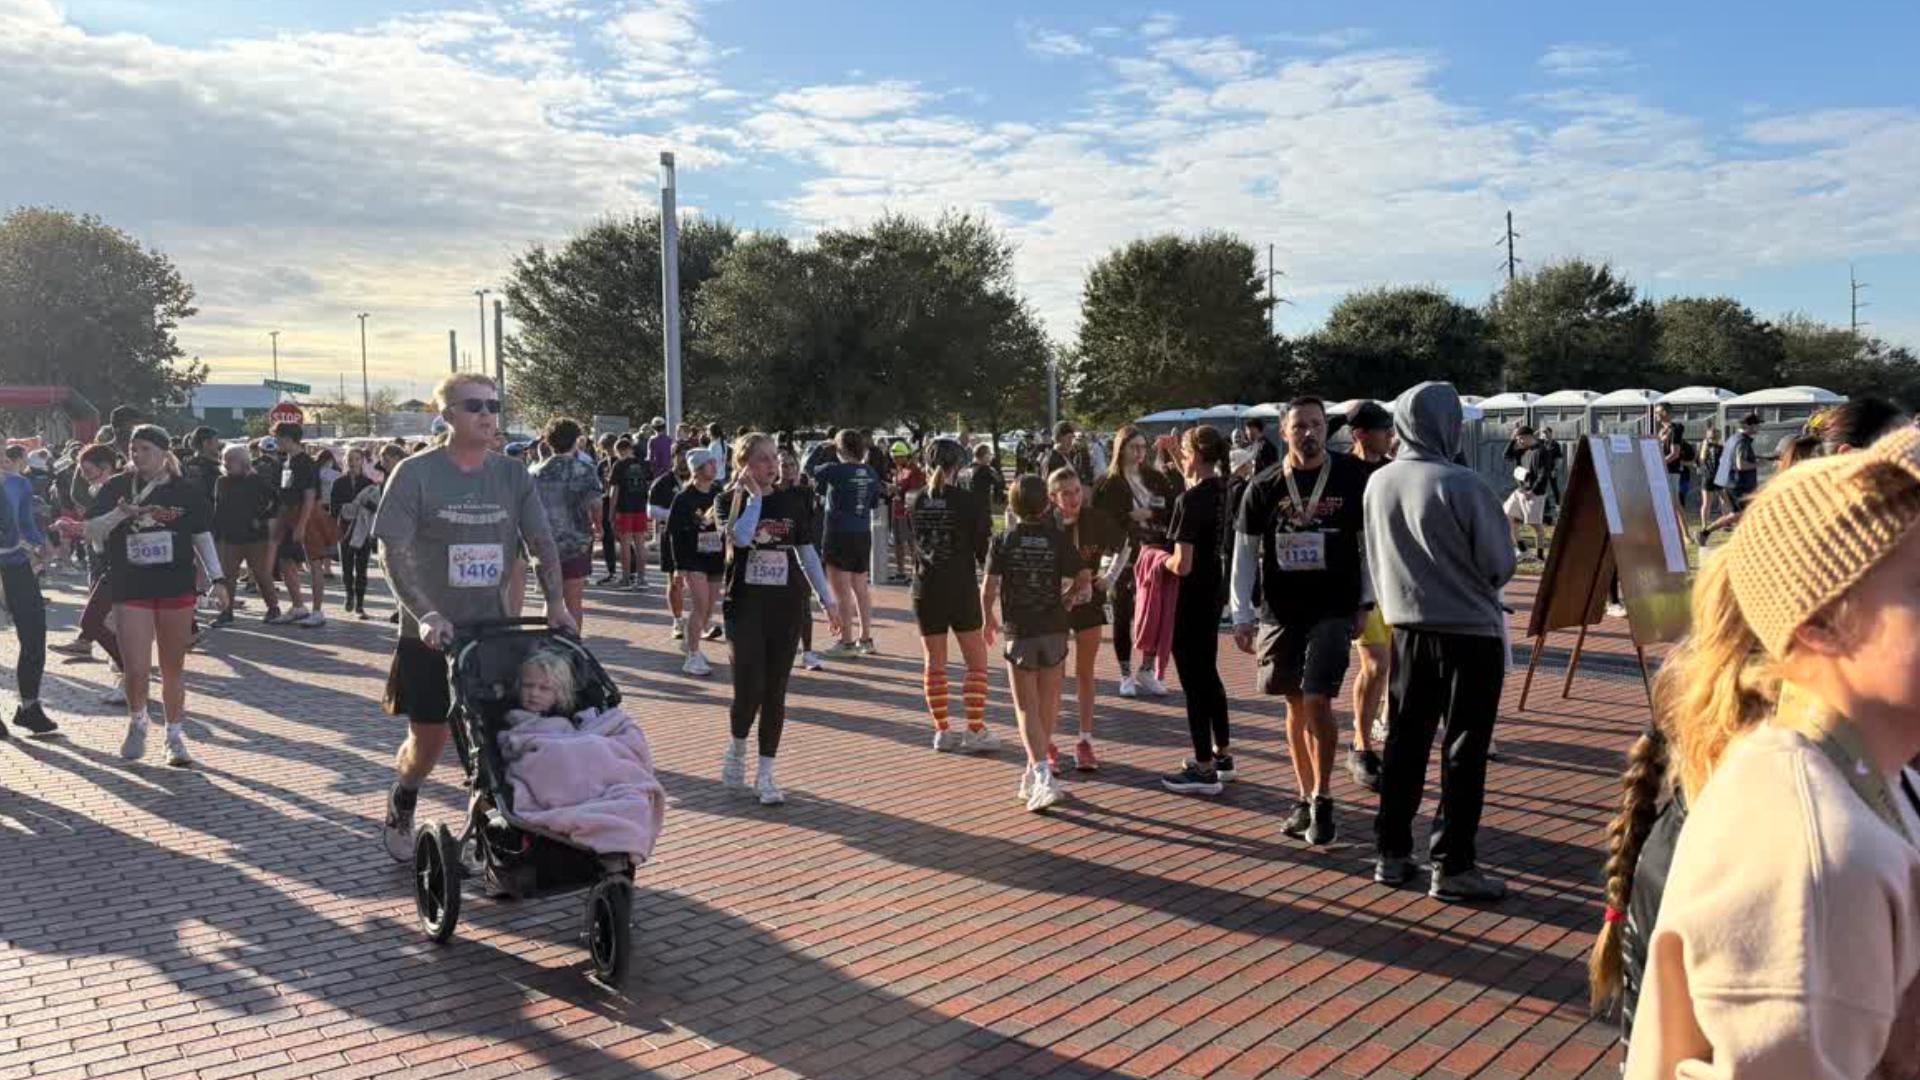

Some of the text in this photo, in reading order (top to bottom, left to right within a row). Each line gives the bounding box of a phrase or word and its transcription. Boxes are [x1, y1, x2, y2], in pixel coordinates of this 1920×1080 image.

[272, 412, 302, 423] STOP
[459, 563, 498, 578] 1416
[753, 565, 785, 579] 1547
